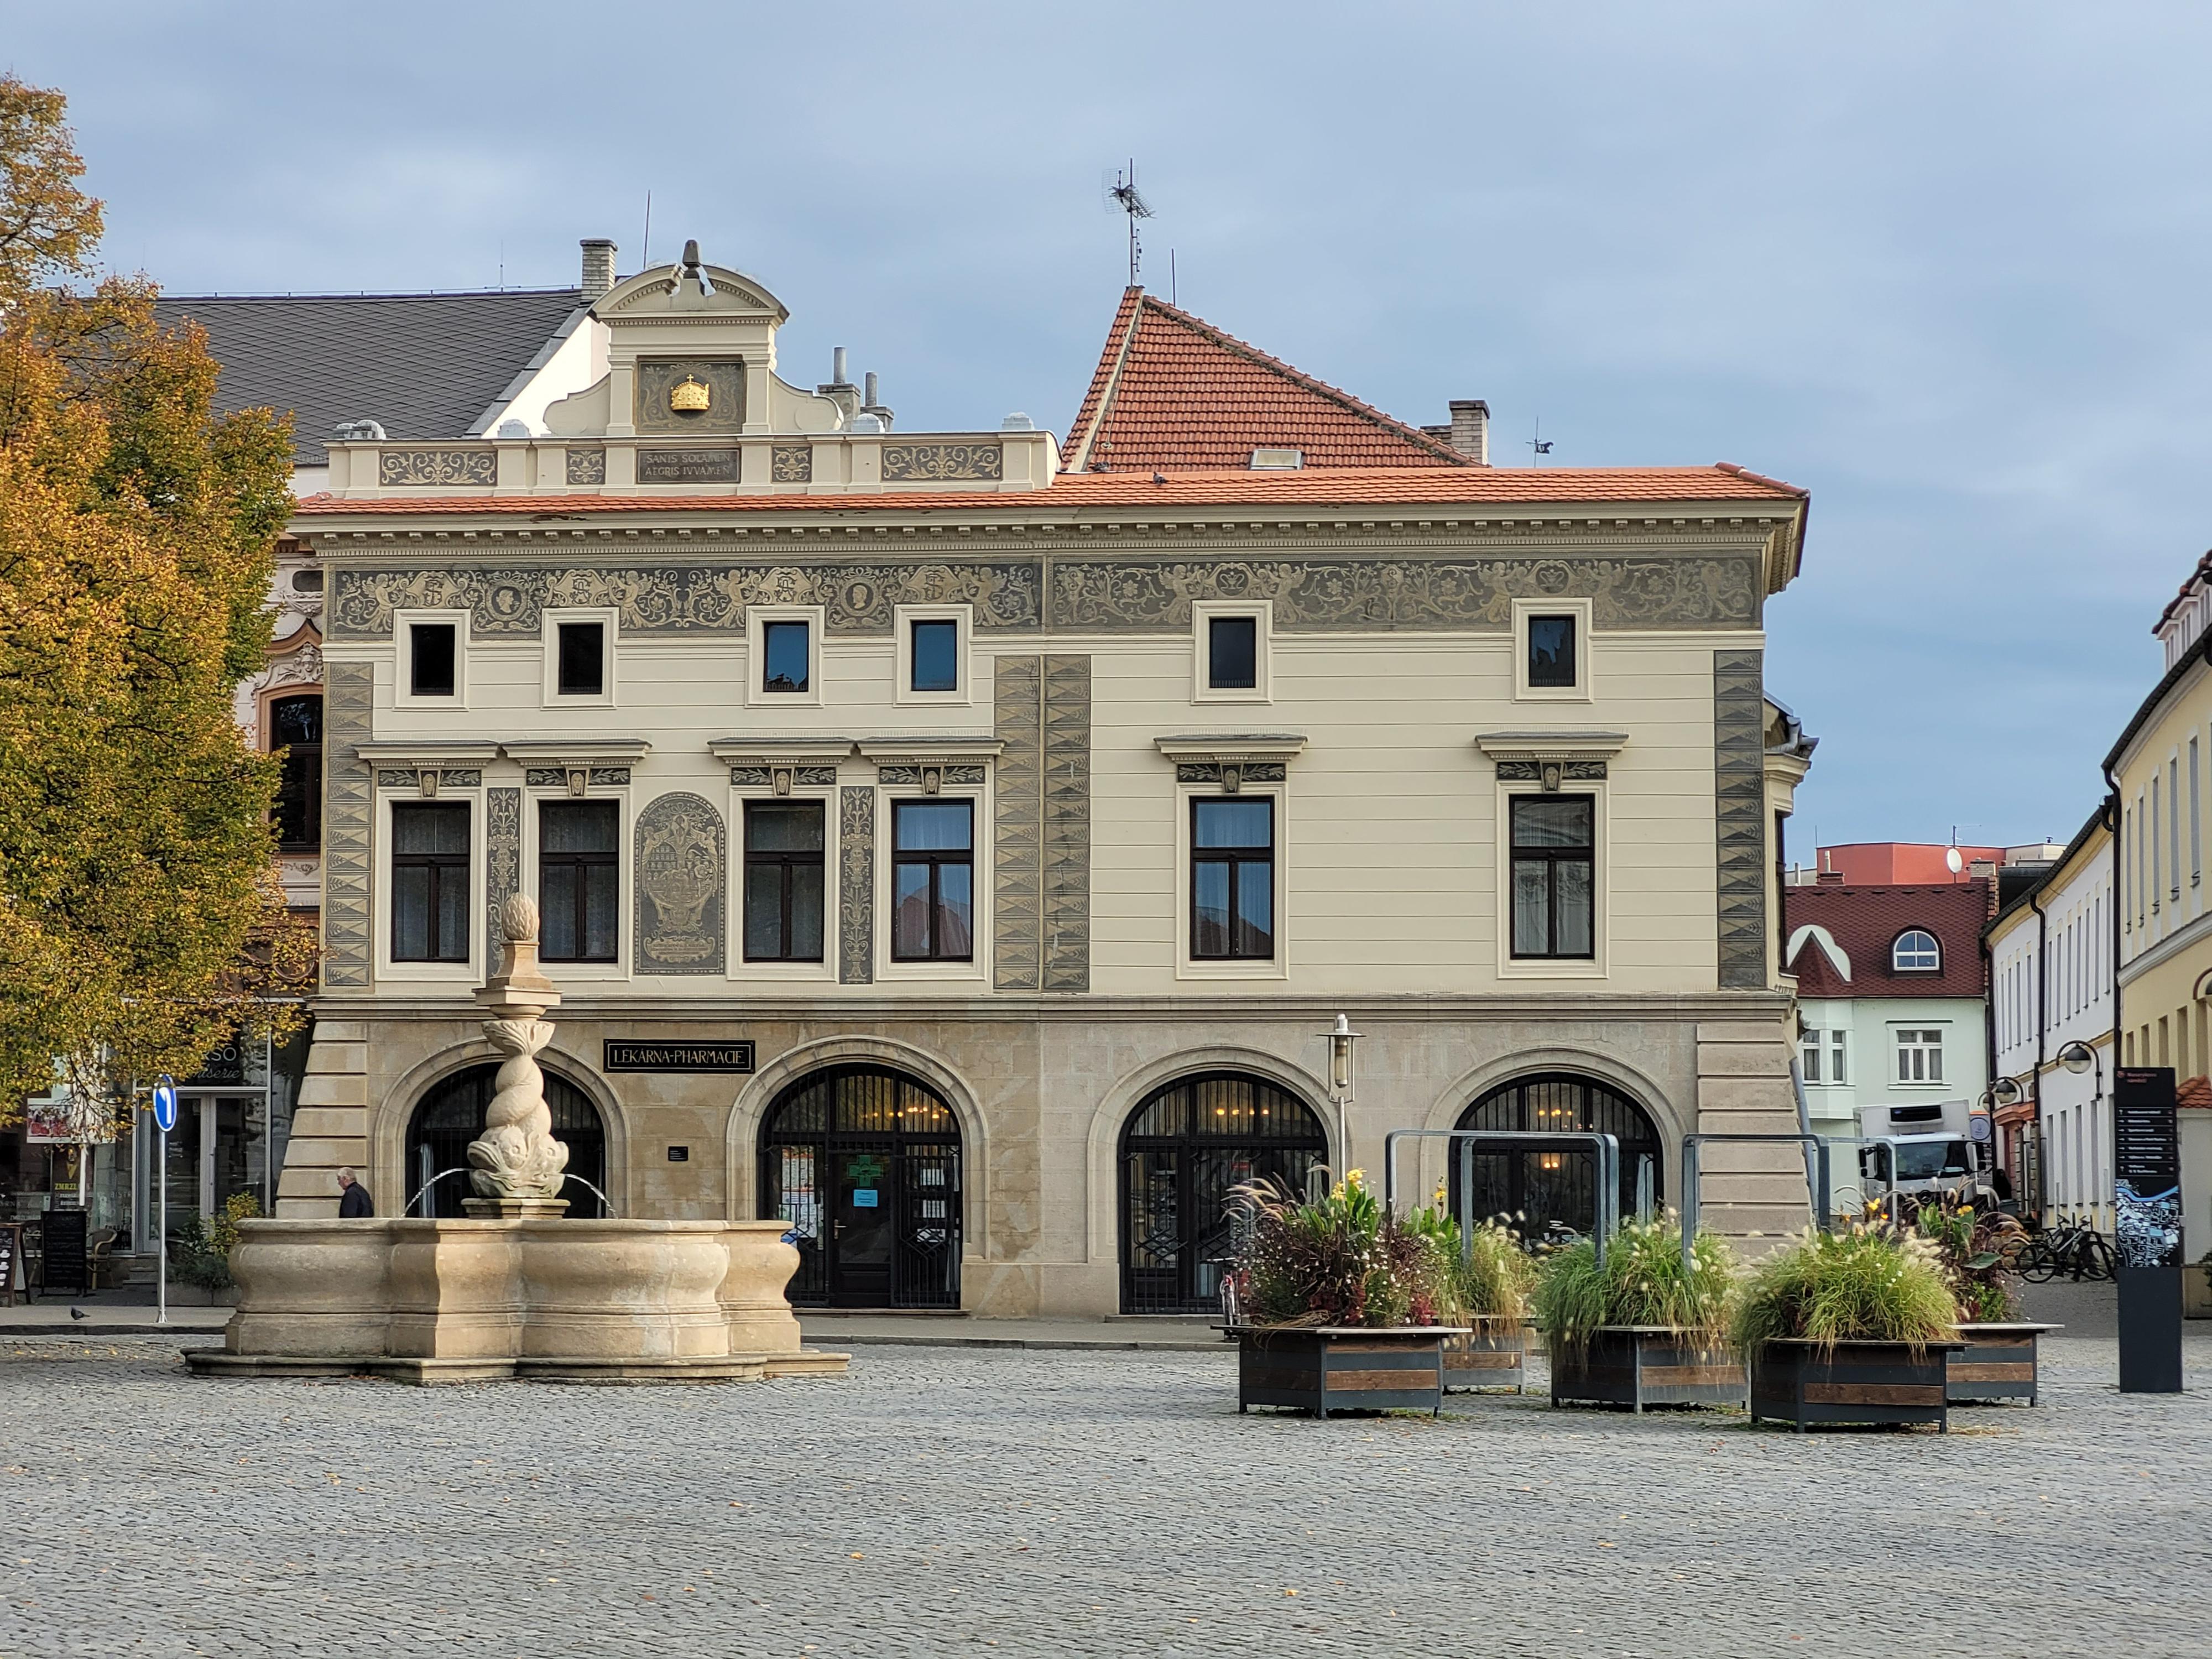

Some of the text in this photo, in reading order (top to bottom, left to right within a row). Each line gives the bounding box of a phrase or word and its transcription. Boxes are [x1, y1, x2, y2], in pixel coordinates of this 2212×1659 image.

[646, 453, 731, 463] SANIS SOLAMEN
[645, 467, 680, 476] AEGRIS
[614, 1048, 745, 1064] LÉKÁRNA-PHARMACIE
[54, 1182, 78, 1191] ZMRZL
